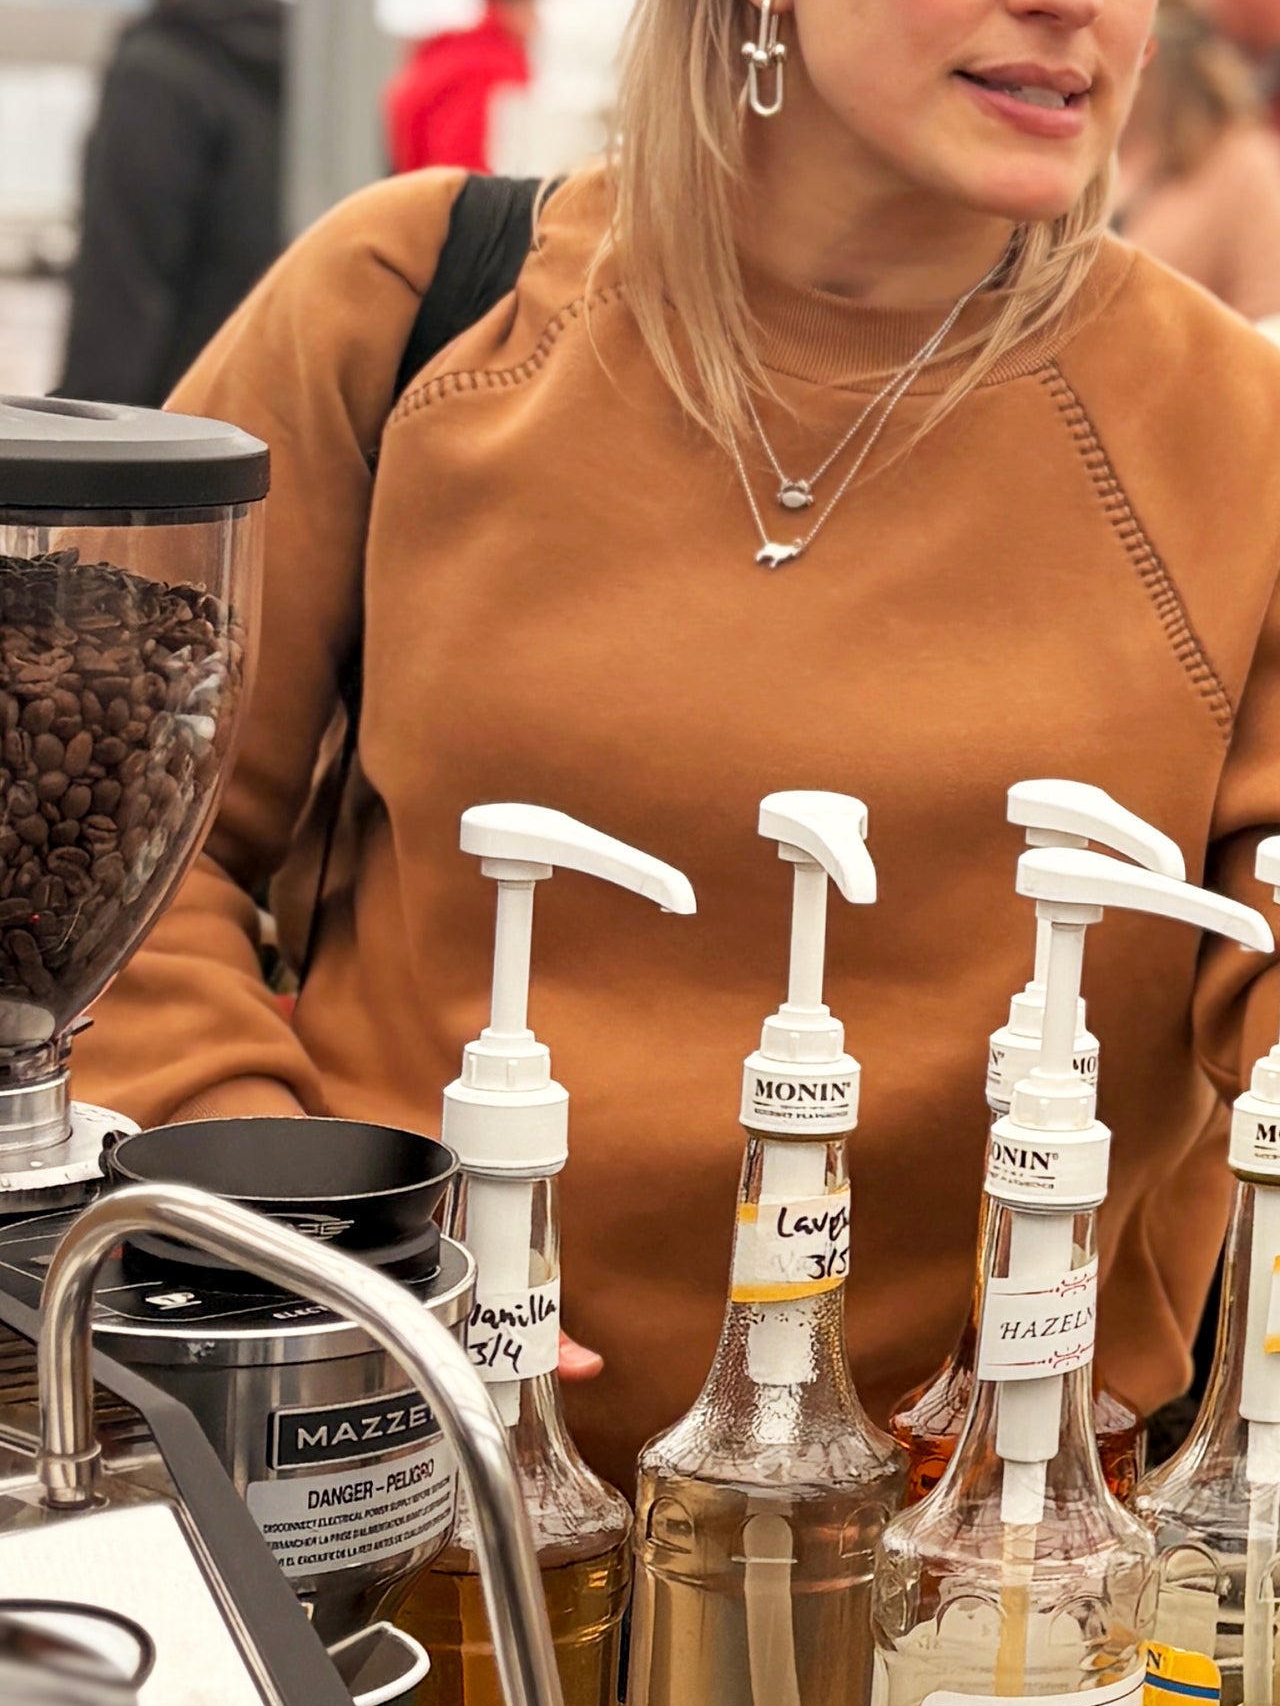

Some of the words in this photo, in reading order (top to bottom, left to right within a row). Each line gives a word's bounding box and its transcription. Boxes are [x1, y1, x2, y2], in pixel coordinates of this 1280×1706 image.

[755, 1078, 846, 1101] MONIN
[469, 1333, 522, 1373] 3/4
[297, 1405, 435, 1450] MAZZE
[307, 1482, 373, 1509] DANGER
[386, 1459, 434, 1494] PELIGRO
